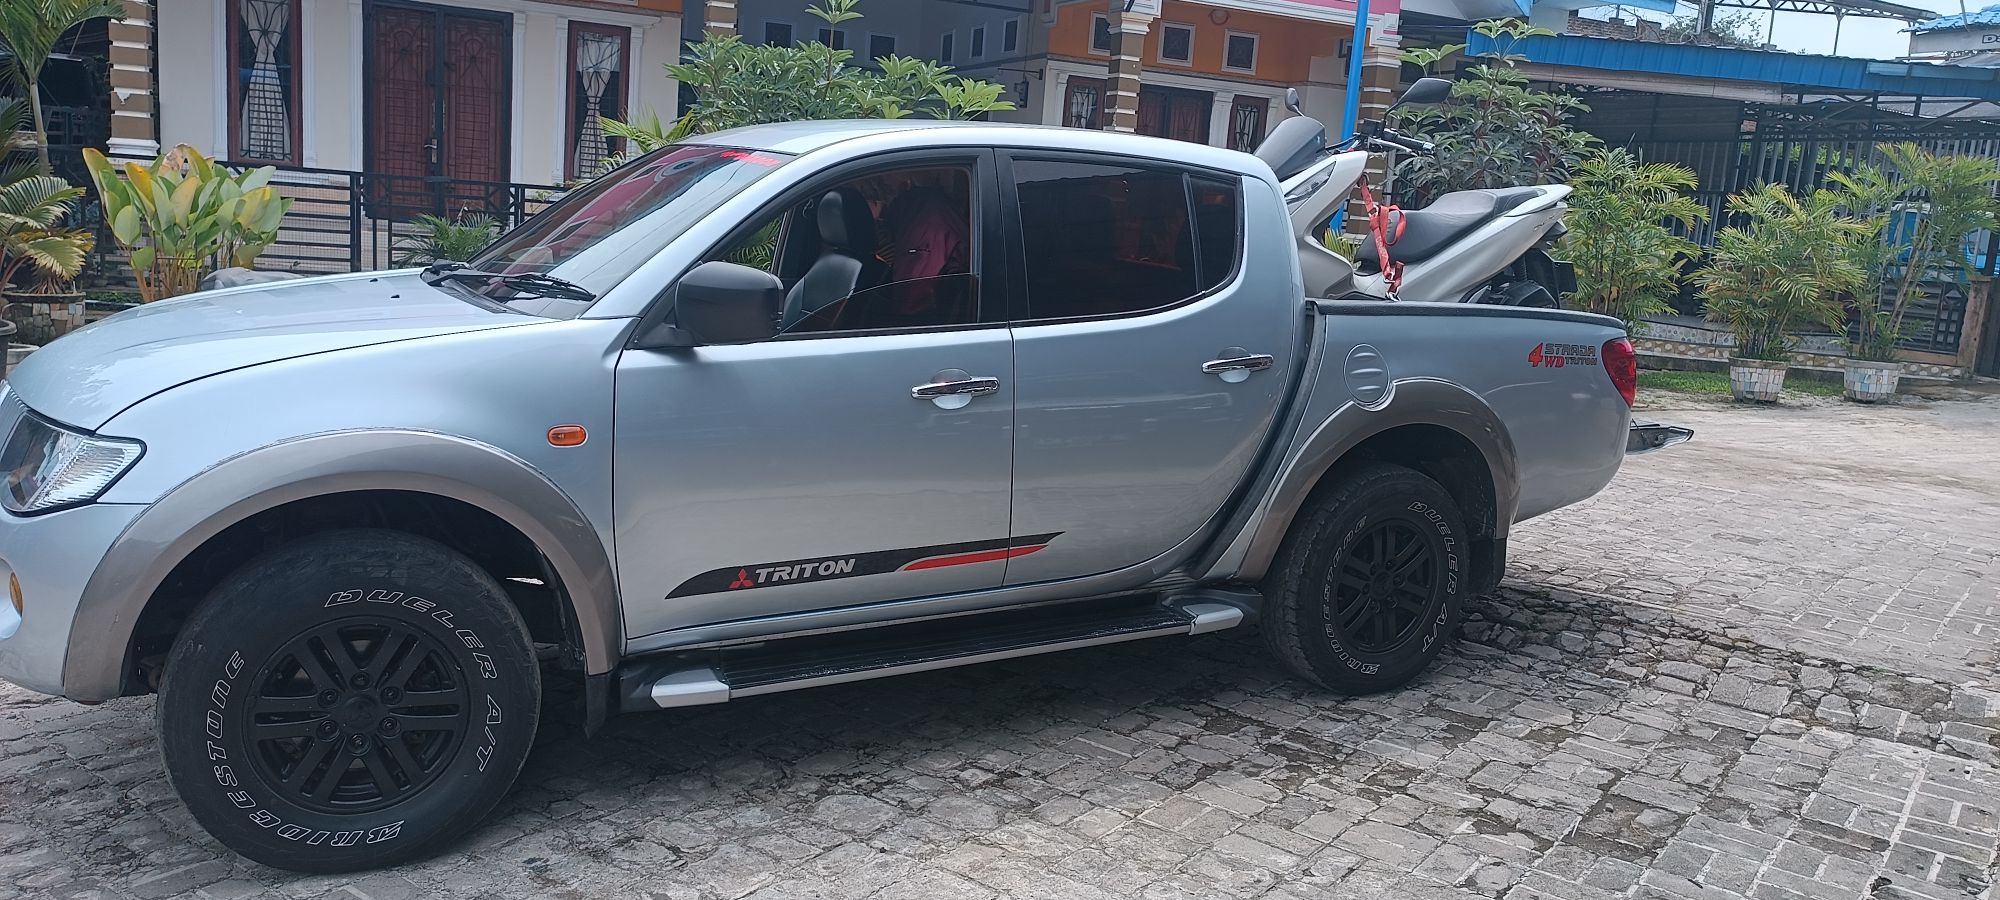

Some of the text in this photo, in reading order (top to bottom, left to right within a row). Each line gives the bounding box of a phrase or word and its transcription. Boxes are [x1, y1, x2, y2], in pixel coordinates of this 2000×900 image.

[1544, 343, 1596, 357] STRADA
[1564, 356, 1597, 366] TRITON
[755, 558, 856, 583] TRITON
[1407, 501, 1459, 653] DUELER A/T
[324, 588, 502, 772] DUELER A/T
[205, 650, 405, 847] BRIDGESTONE
